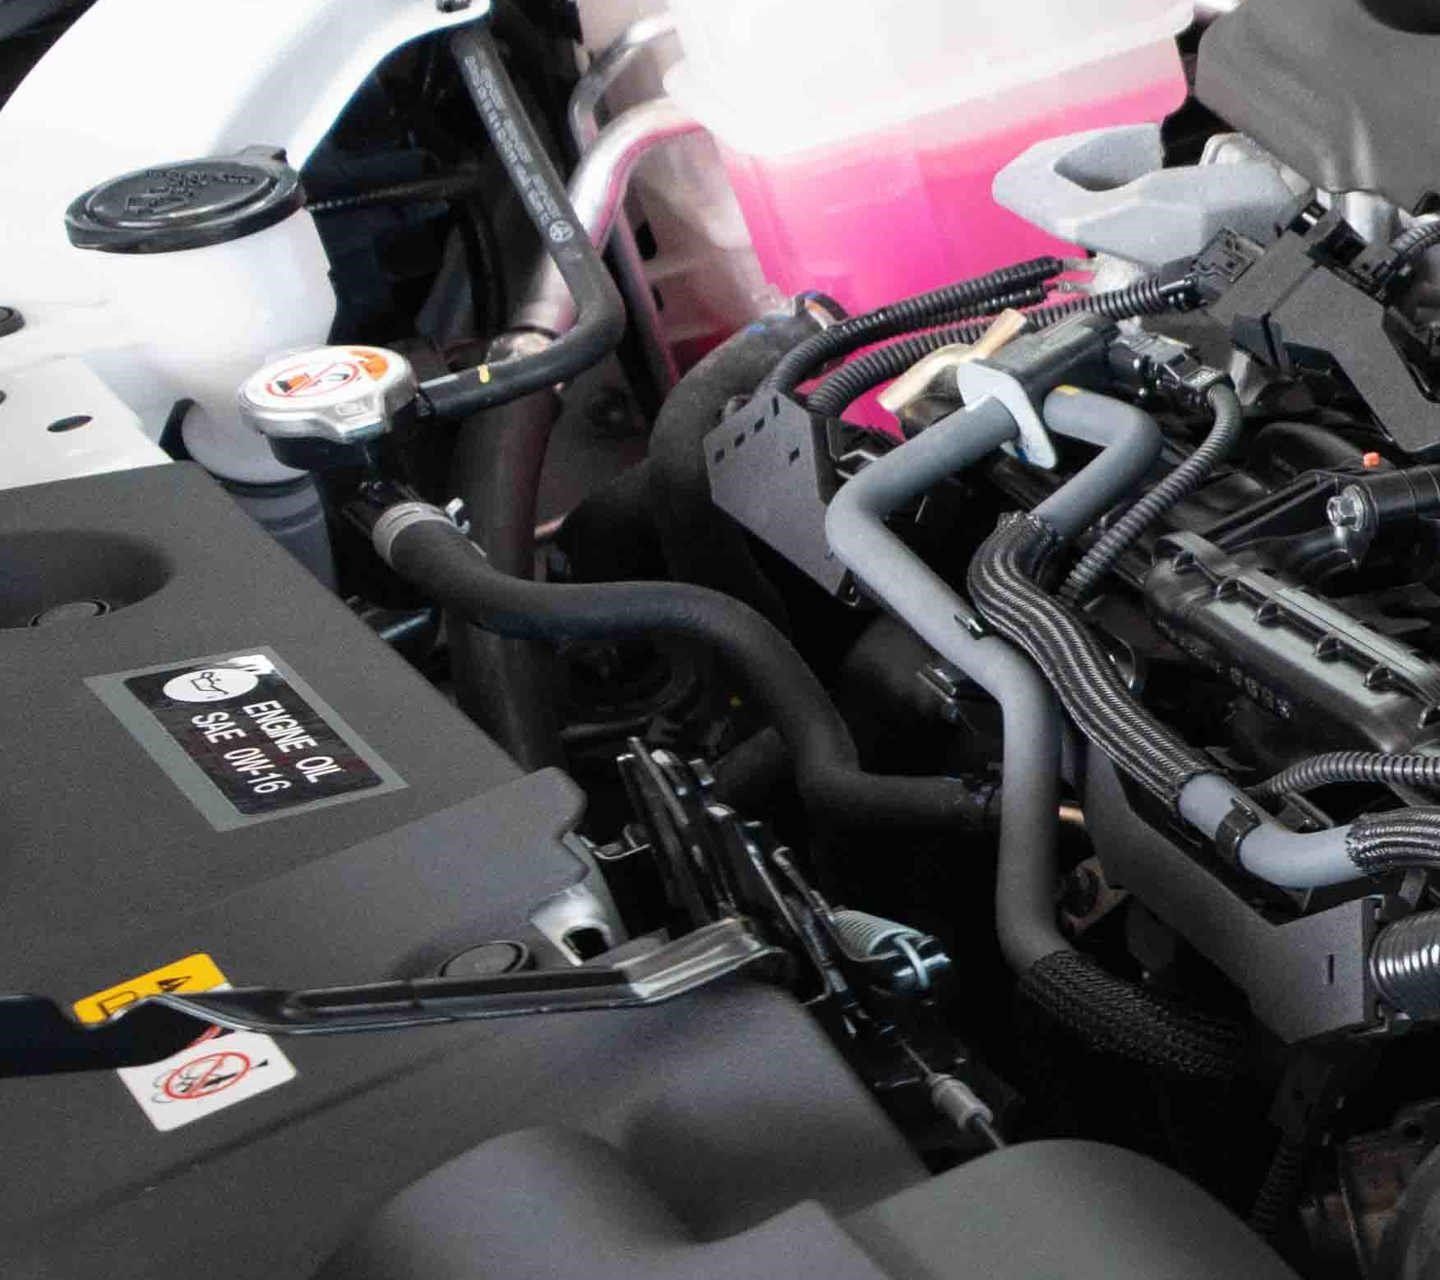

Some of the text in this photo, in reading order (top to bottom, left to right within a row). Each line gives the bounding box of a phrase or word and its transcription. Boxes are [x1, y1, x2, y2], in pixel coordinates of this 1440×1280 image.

[191, 711, 292, 794] SAE 0W-16
[242, 699, 346, 783] ENGINE OIL
